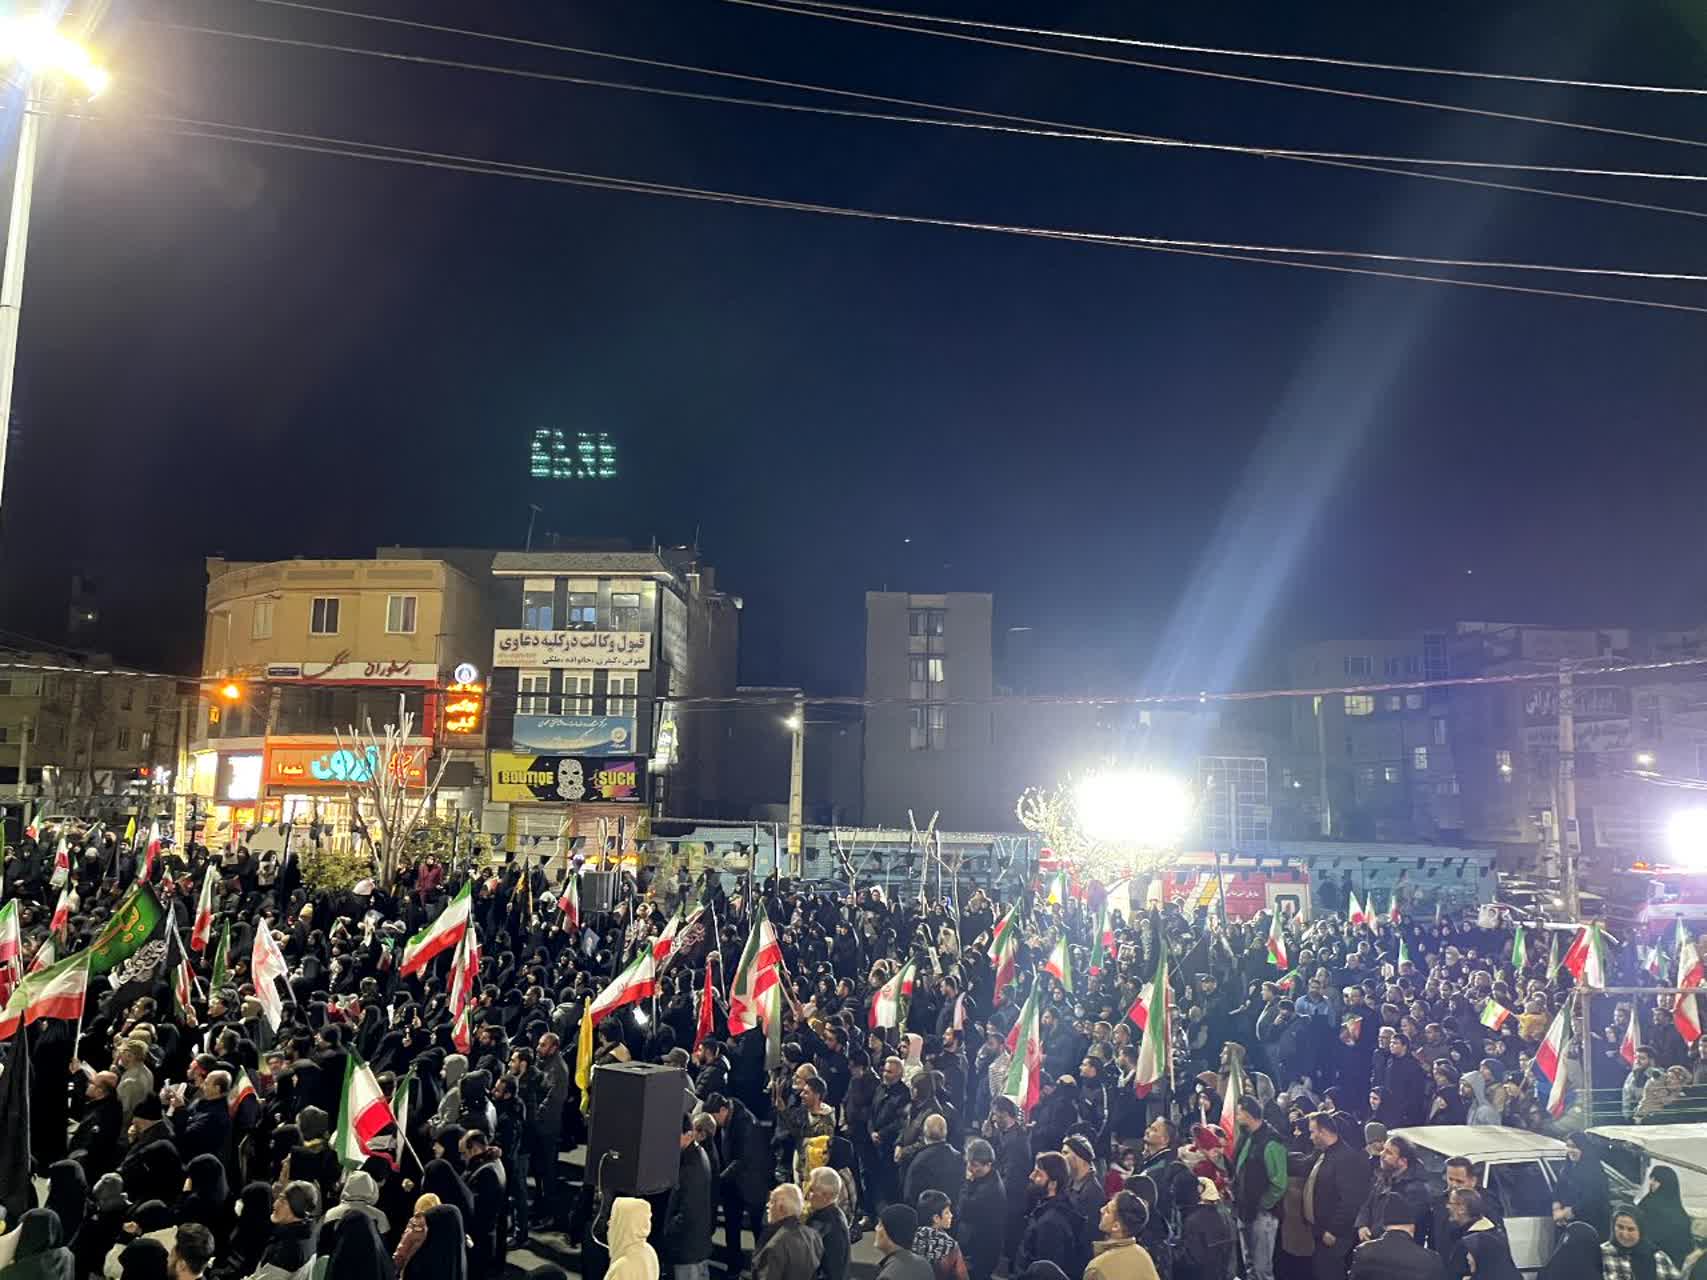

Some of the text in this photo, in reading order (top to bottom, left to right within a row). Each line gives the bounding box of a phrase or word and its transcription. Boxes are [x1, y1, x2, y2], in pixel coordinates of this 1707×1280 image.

[500, 632, 539, 651] دعاوی
[541, 632, 564, 651] کلیه
[580, 632, 614, 652] وکالت
[617, 632, 645, 652] قبول
[599, 771, 636, 786] SUCH
